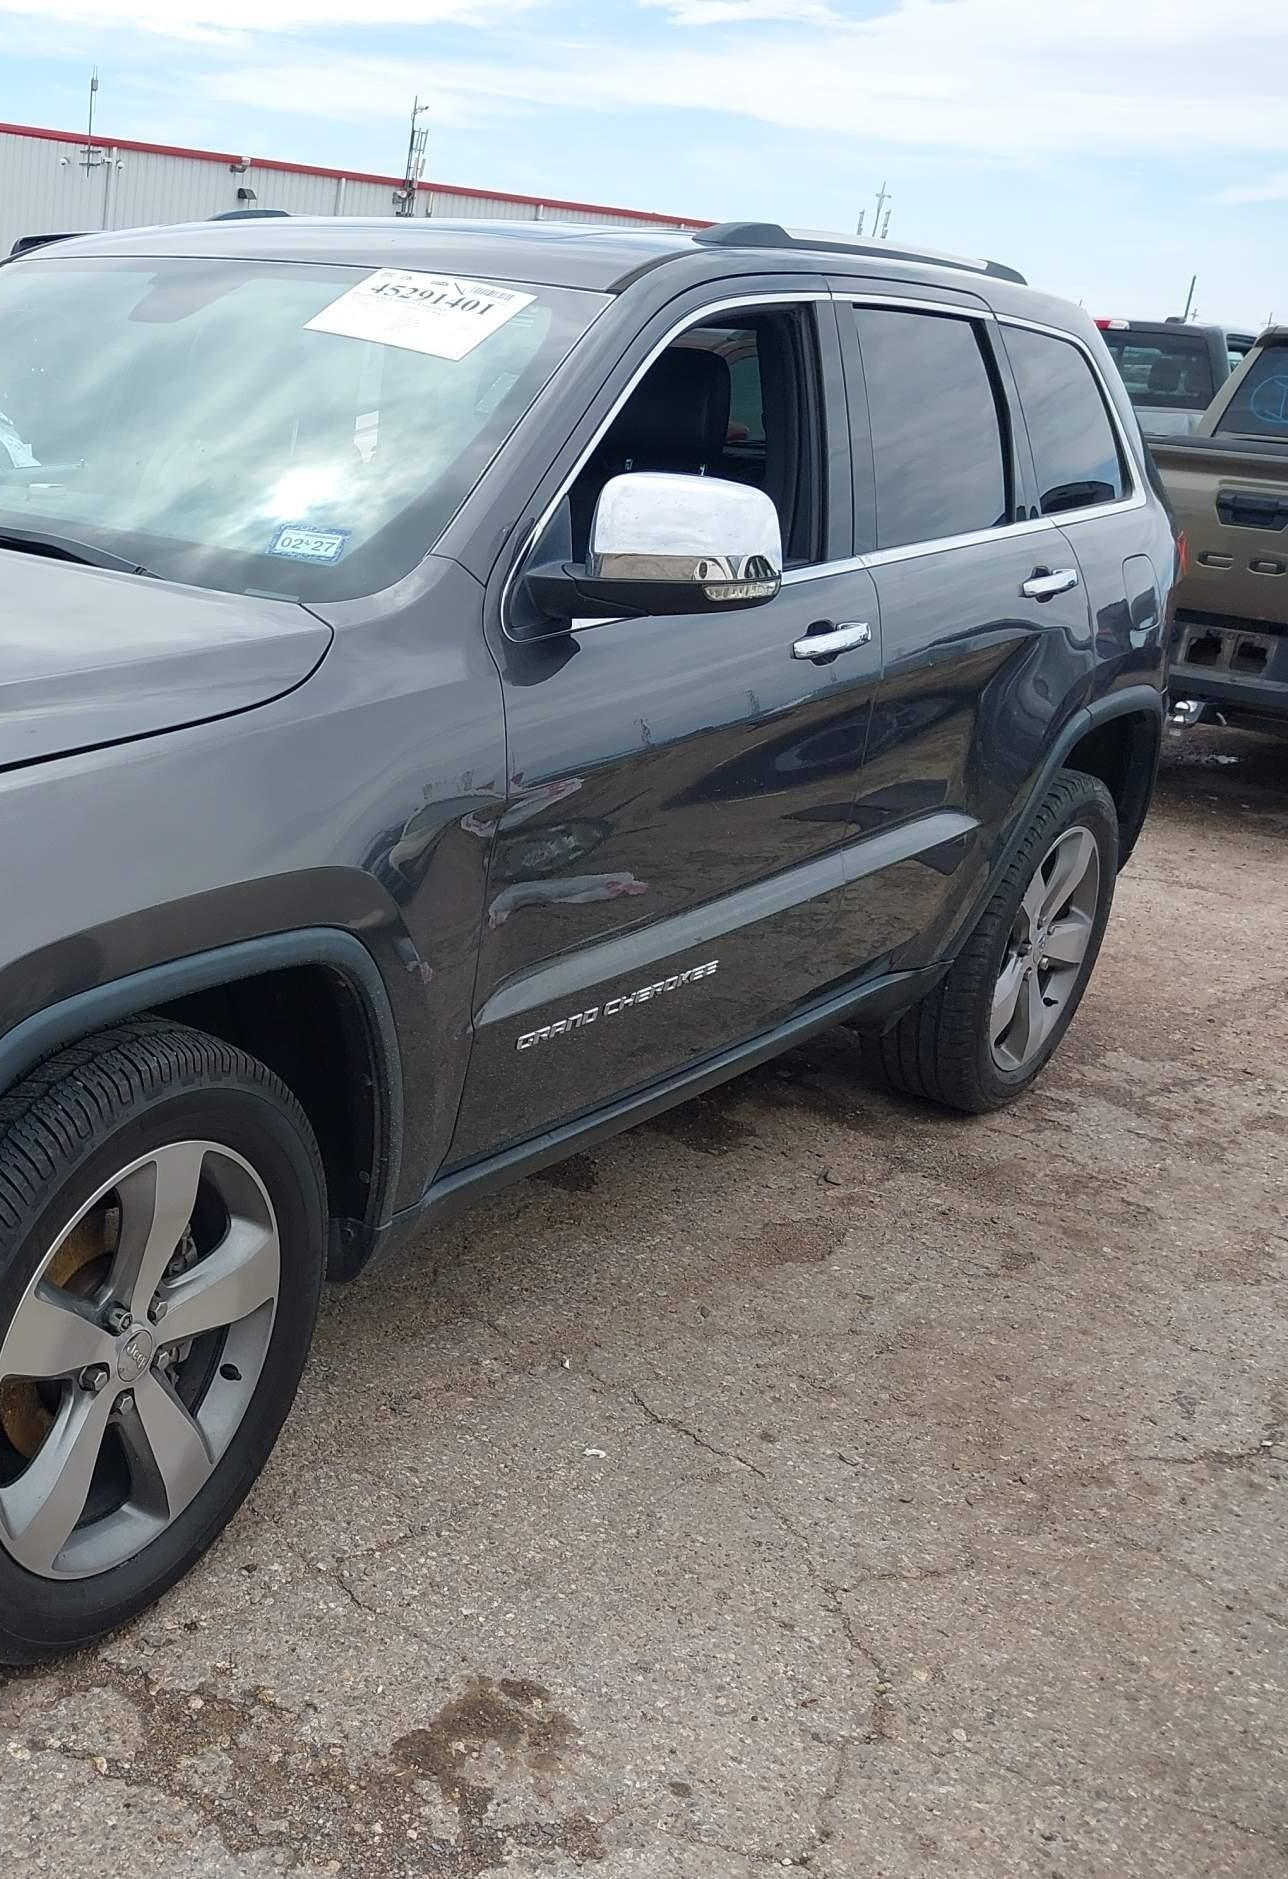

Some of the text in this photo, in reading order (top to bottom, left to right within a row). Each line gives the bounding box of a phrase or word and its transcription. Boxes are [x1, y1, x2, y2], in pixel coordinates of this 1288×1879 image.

[371, 282, 495, 315] 45291401
[516, 960, 719, 1050] GRAND CHEROKEE
[126, 1343, 146, 1369] Jeep
